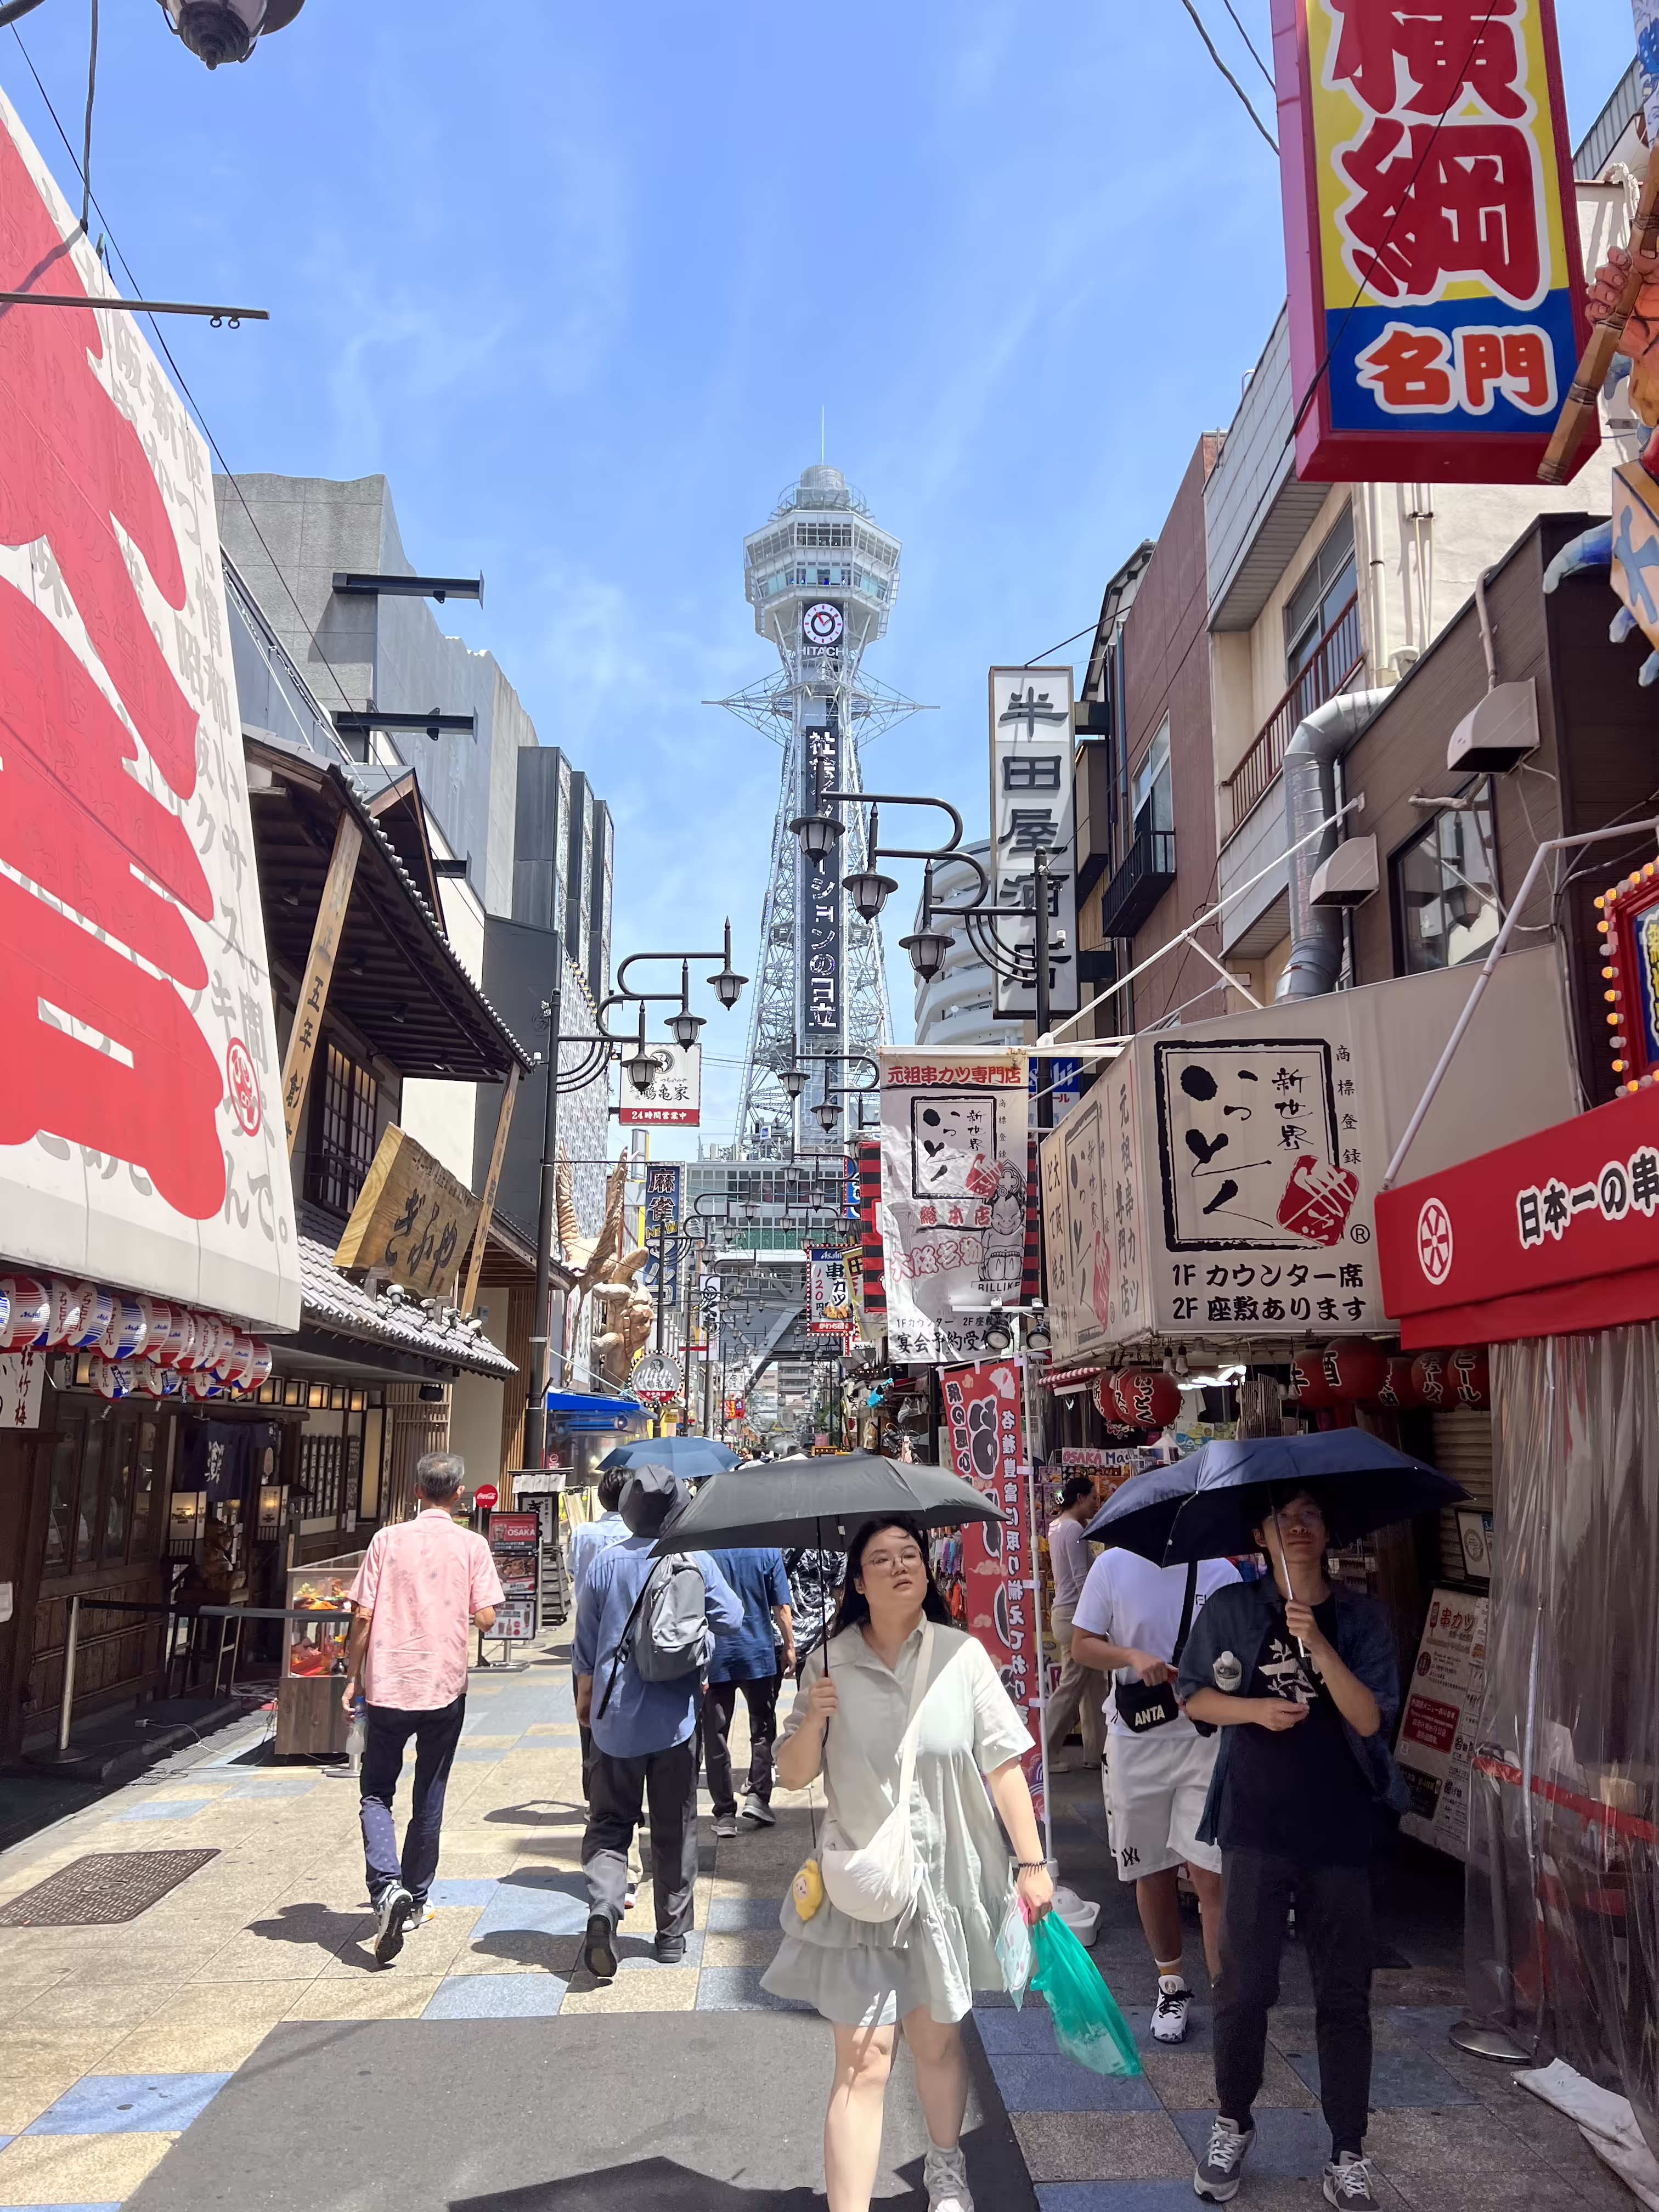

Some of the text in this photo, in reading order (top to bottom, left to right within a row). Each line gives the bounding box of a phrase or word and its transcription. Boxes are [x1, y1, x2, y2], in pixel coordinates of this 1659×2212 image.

[1332, 0, 1544, 301] 横綱
[1361, 325, 1554, 413] 名門
[797, 646, 848, 657] HITACHI
[888, 1066, 1022, 1084] 元祖串カツ専門店
[631, 1110, 687, 1120] 24時間営業中
[1271, 1068, 1314, 1151] 新世界
[1335, 1045, 1361, 1164] 商標登録
[967, 1109, 986, 1152] 新世界
[998, 1098, 1007, 1159] 商標登録
[1180, 1063, 1273, 1229] いっとく
[647, 1167, 675, 1221] 麻雀
[1087, 1139, 1098, 1231] 新世界
[1119, 1084, 1139, 1313] 元祖串カツ
[921, 1205, 994, 1227] 総本店
[890, 1237, 984, 1282] 大阪名物
[1115, 1182, 1131, 1319] 専門店
[826, 1262, 845, 1307] 串カツ
[1173, 1263, 1363, 1288] 1F カウンター席
[55, 1291, 67, 1333] アサヒビール
[897, 1319, 906, 1328] 1F
[909, 1317, 954, 1328] カウンター
[963, 1317, 974, 1327] 2F
[1173, 1296, 1366, 1322] 2F 座敷あります
[15, 1346, 33, 1426] 松竹梅
[1132, 1375, 1157, 1425] いっとく
[1454, 1351, 1482, 1403] ビール
[1063, 1451, 1102, 1464] OSAKA
[1135, 1705, 1166, 1726] ANTA
